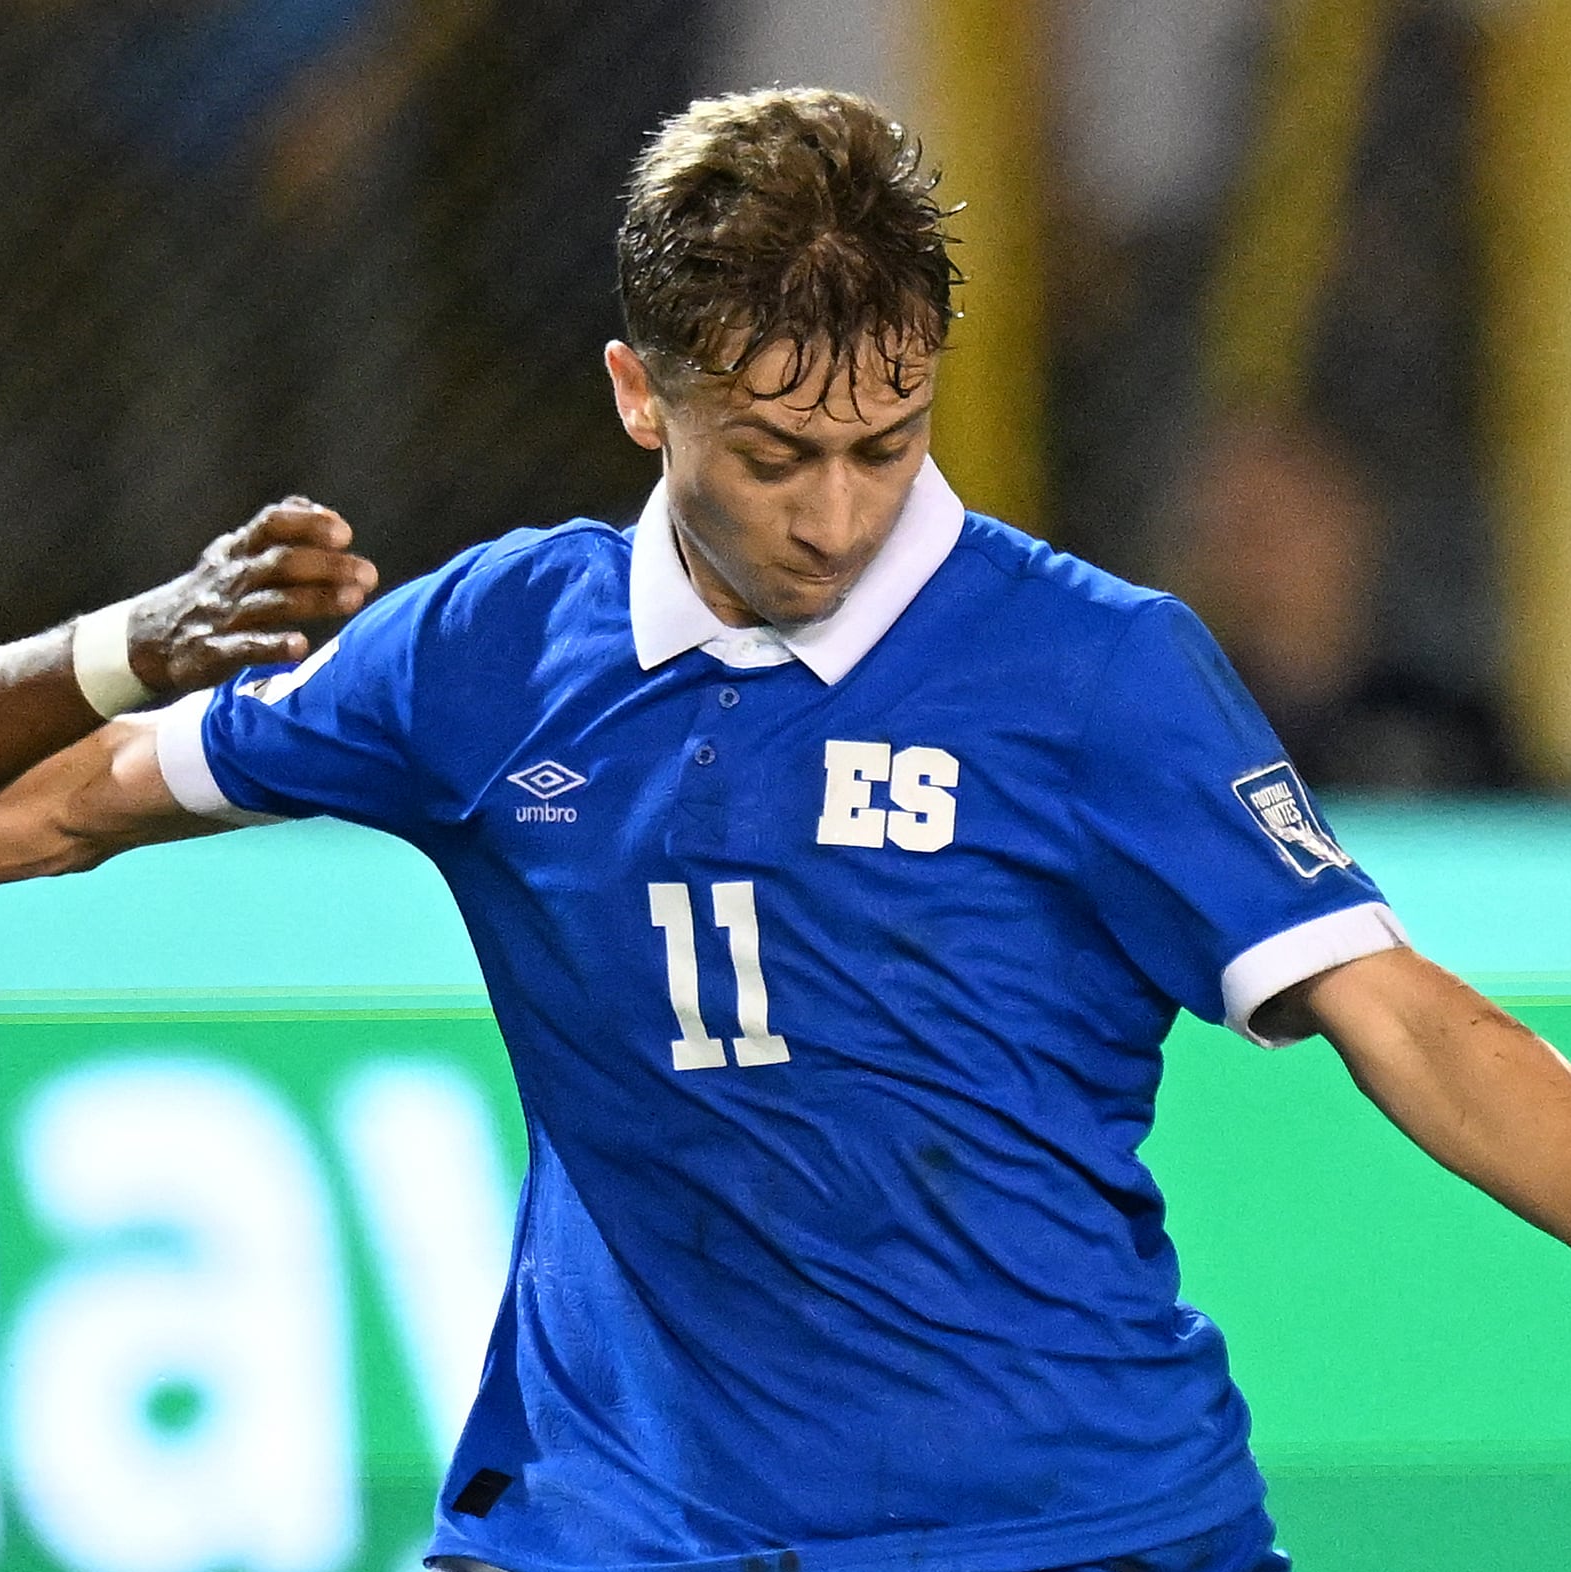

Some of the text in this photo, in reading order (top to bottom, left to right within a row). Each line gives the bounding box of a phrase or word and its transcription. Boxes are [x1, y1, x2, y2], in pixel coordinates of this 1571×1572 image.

[515, 802, 578, 824] umbro
[816, 739, 960, 853] ES
[647, 881, 792, 1072] 11
